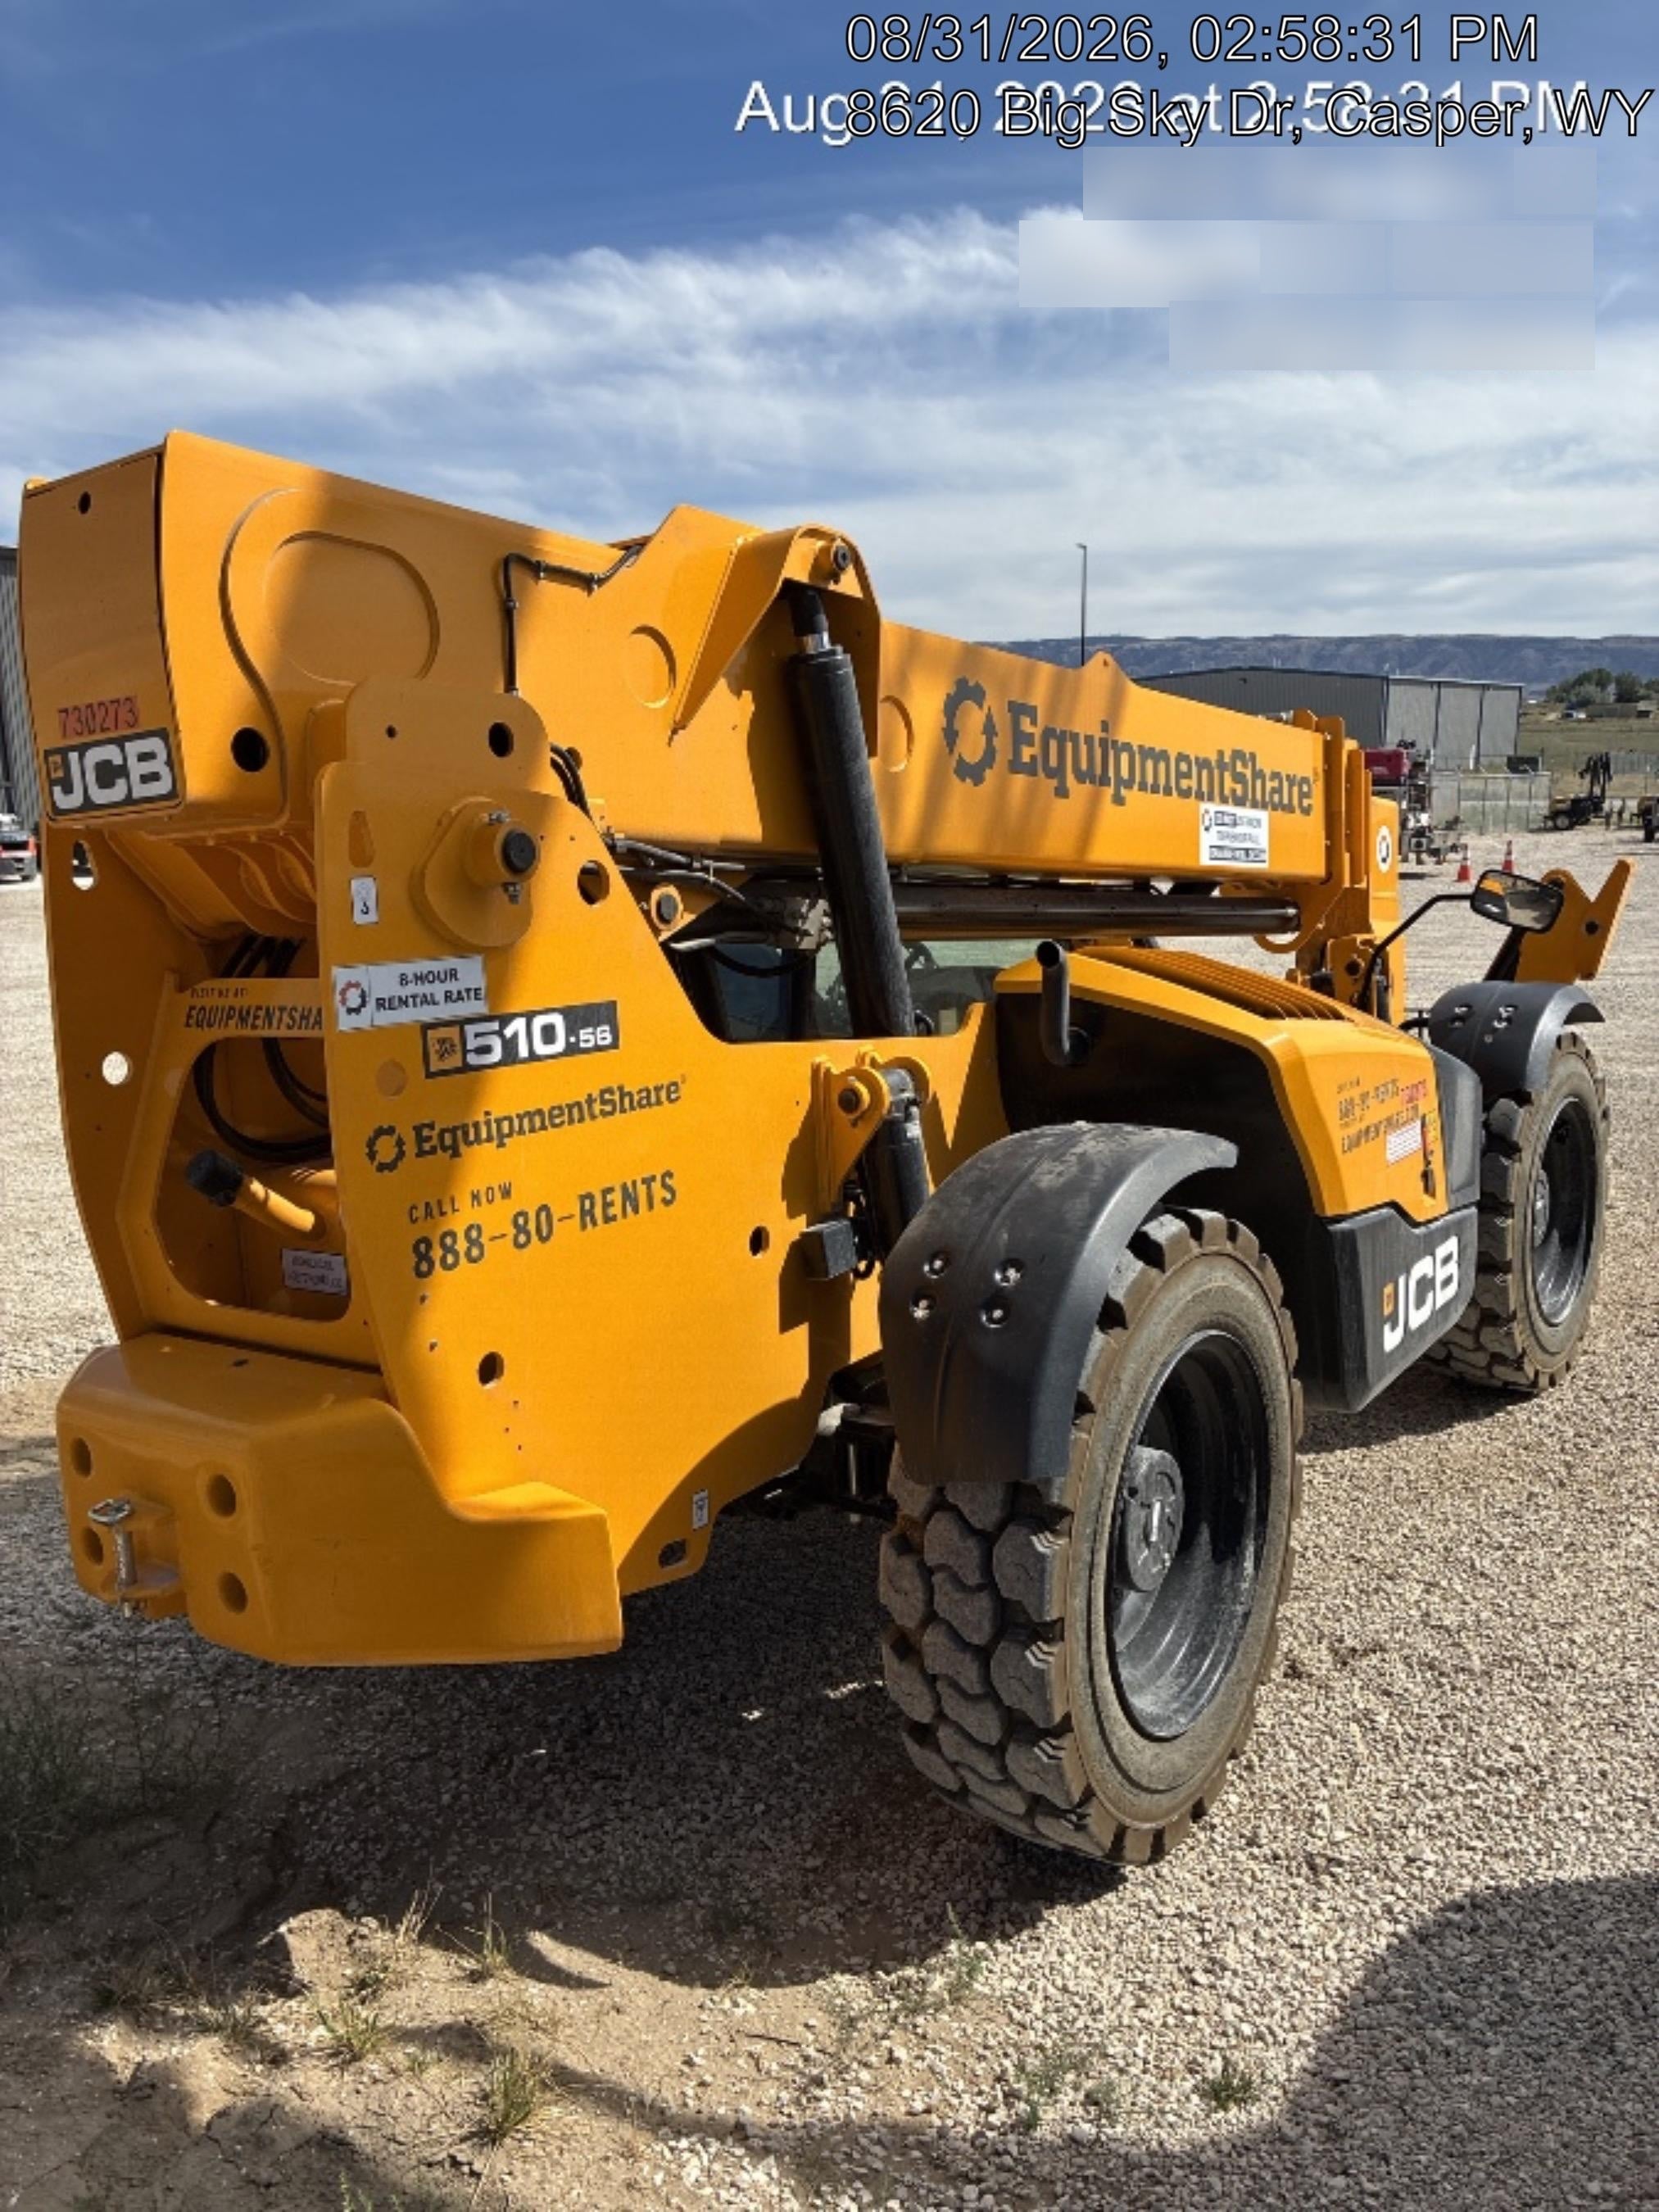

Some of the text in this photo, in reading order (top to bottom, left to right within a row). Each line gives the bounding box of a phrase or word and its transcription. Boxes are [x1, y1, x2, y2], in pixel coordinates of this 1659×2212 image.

[57, 696, 138, 737] 730273
[52, 737, 174, 810] JCB
[1006, 699, 1313, 817] EquipmentShare
[374, 986, 483, 1012] RENTAL RATE
[398, 968, 460, 987] 8-HOUR
[412, 1080, 682, 1159] EquipmentShare
[407, 1181, 513, 1225] CALL NOW
[411, 1169, 678, 1281] 888-80-RENTS
[1383, 1235, 1459, 1353] JCB
